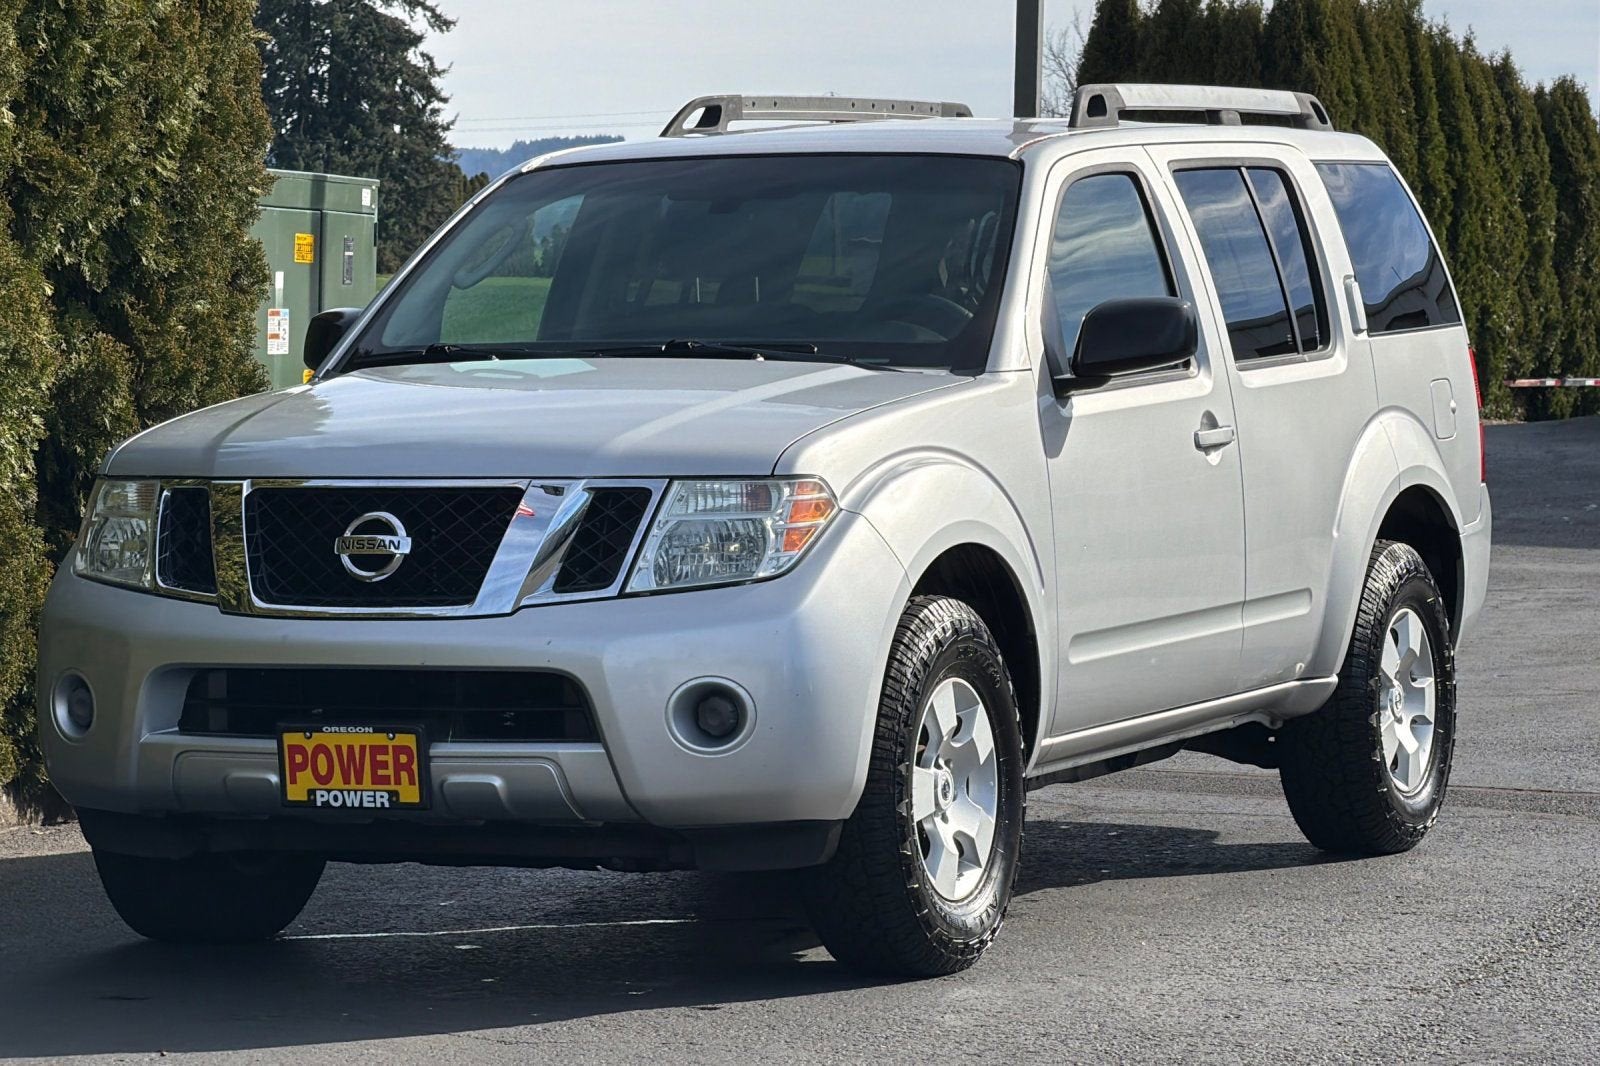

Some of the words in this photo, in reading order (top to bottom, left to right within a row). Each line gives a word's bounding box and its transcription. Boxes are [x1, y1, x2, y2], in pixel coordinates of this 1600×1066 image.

[340, 539, 401, 550] NISSAN
[287, 743, 416, 786] POWER
[316, 789, 390, 808] POWER
